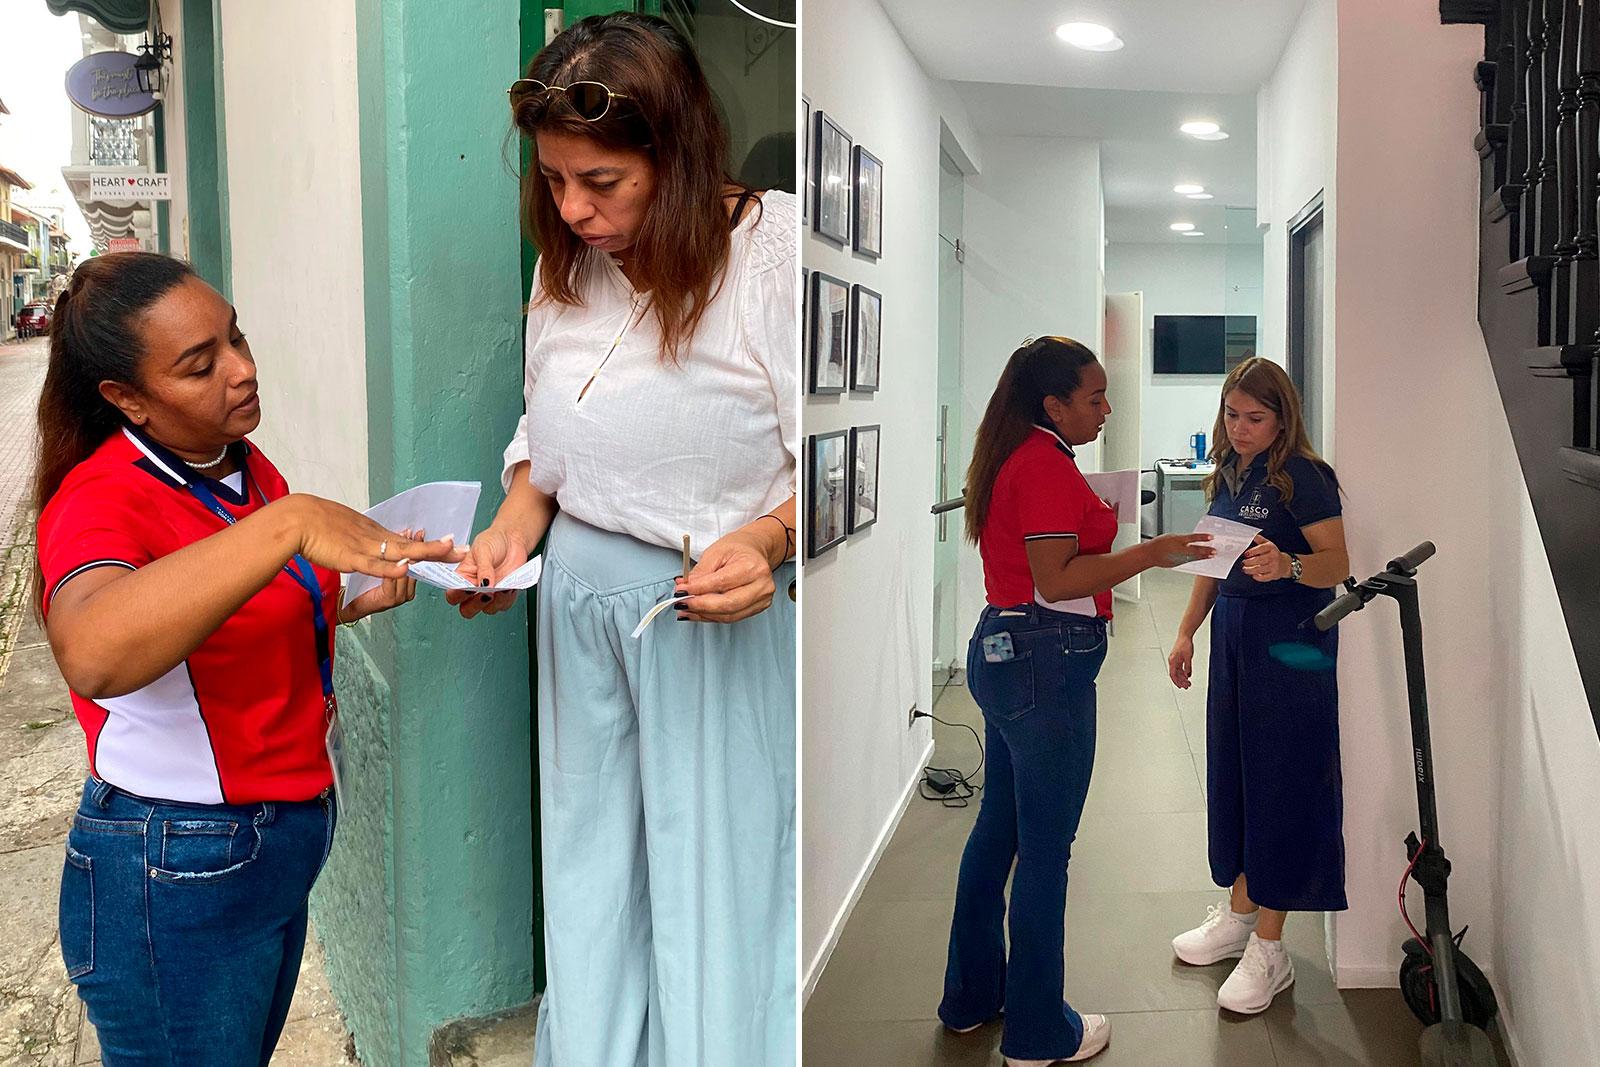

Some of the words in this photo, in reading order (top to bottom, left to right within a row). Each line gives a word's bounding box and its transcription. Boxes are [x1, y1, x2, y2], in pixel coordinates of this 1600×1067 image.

[93, 177, 125, 187] HEART
[137, 177, 168, 187] CRAFT
[1240, 505, 1269, 516] CASCO
